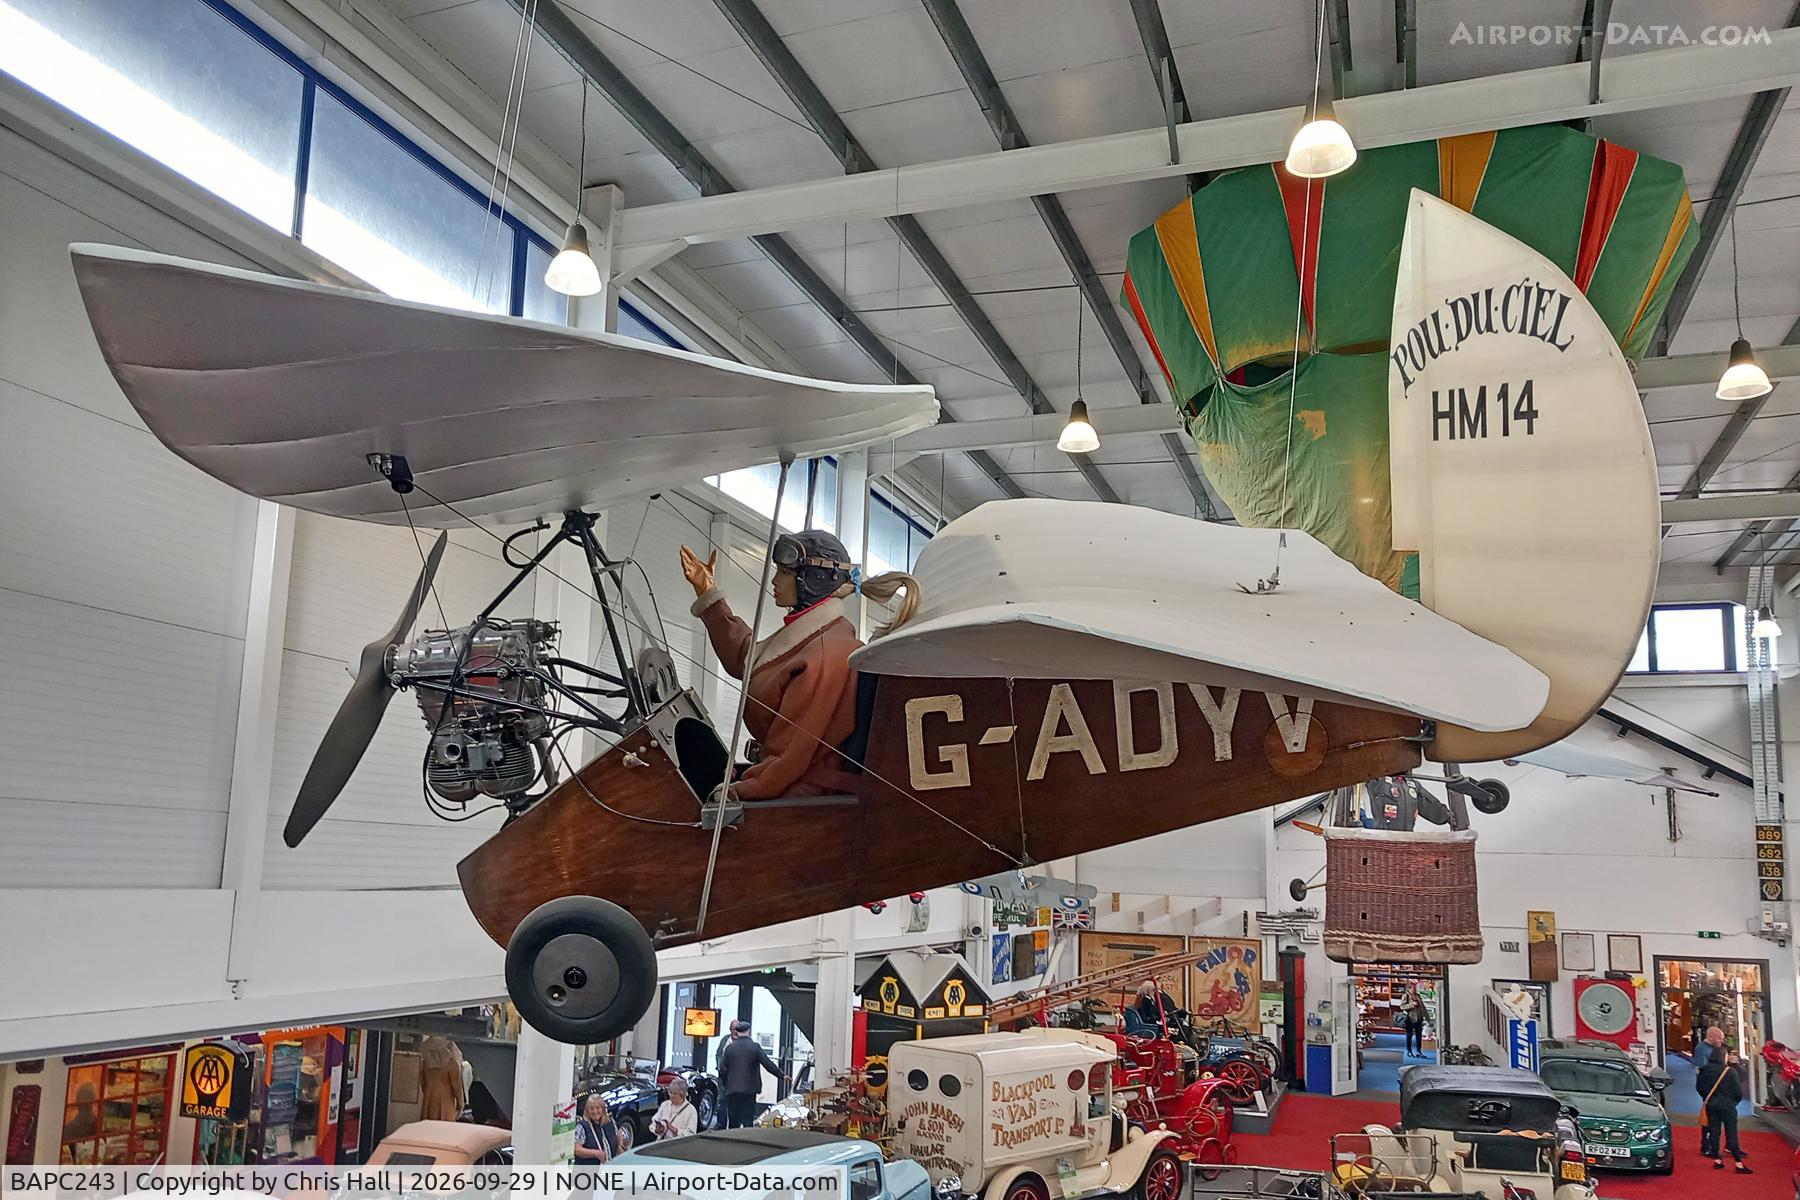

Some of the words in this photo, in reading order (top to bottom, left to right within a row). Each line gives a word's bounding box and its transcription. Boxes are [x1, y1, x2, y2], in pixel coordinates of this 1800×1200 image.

[1432, 385, 1488, 441] HM
[1496, 379, 1539, 437] 14
[1758, 831, 1781, 840] 889
[1759, 849, 1782, 859] 682
[1762, 866, 1781, 877] 138
[1065, 912, 1077, 921] BP
[1195, 946, 1257, 975] FAVOR
[991, 1074, 1056, 1102] BLACKPOOL
[185, 1104, 228, 1118] GARAGE
[900, 1101, 928, 1121] JOHN
[930, 1102, 965, 1133] MARSH
[1006, 1101, 1037, 1124] VAN
[918, 1118, 926, 1130] &
[927, 1119, 945, 1134] SON
[991, 1116, 1054, 1150] TRANSPORT
[909, 1143, 945, 1156] HAULAGE
